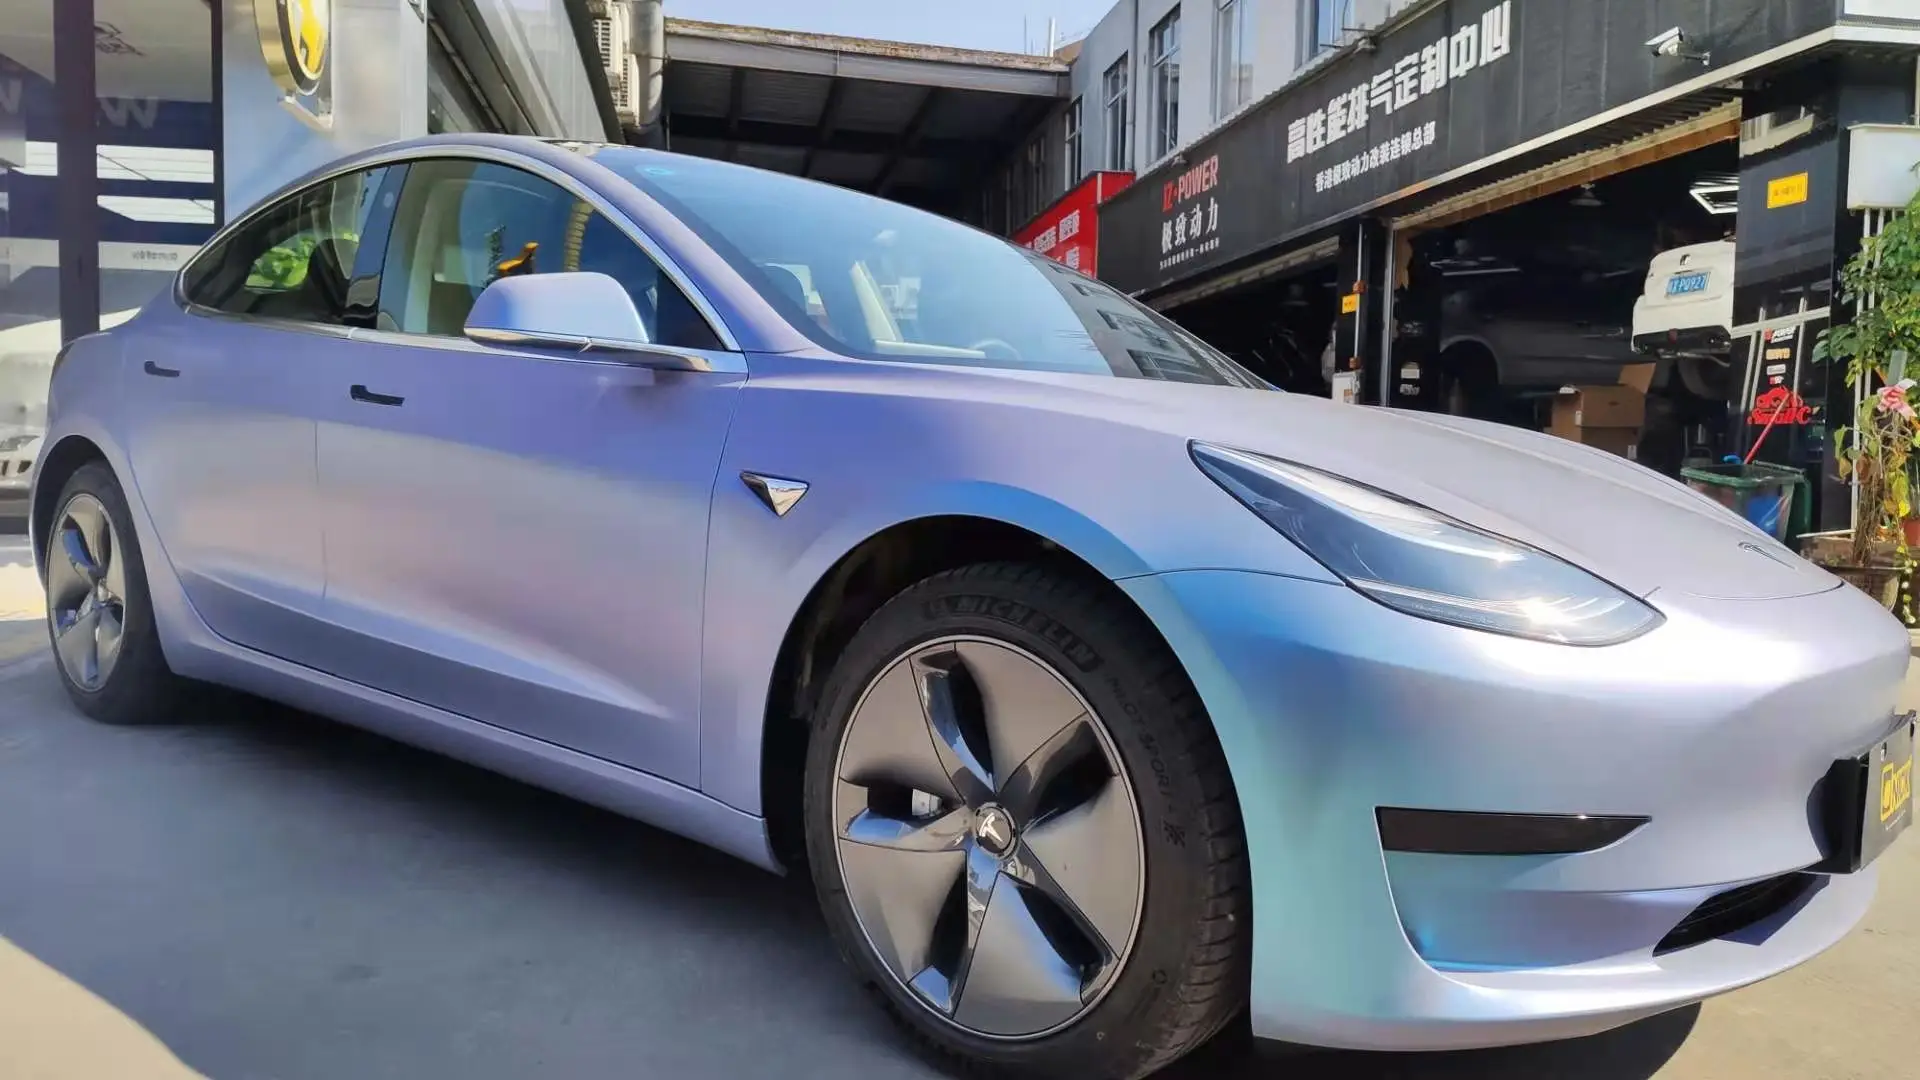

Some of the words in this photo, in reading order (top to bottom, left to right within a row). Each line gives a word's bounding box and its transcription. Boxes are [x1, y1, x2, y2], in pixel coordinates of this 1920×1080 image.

[1287, 0, 1512, 164] 高性能排气定制中心
[1161, 197, 1219, 254] 极致动力
